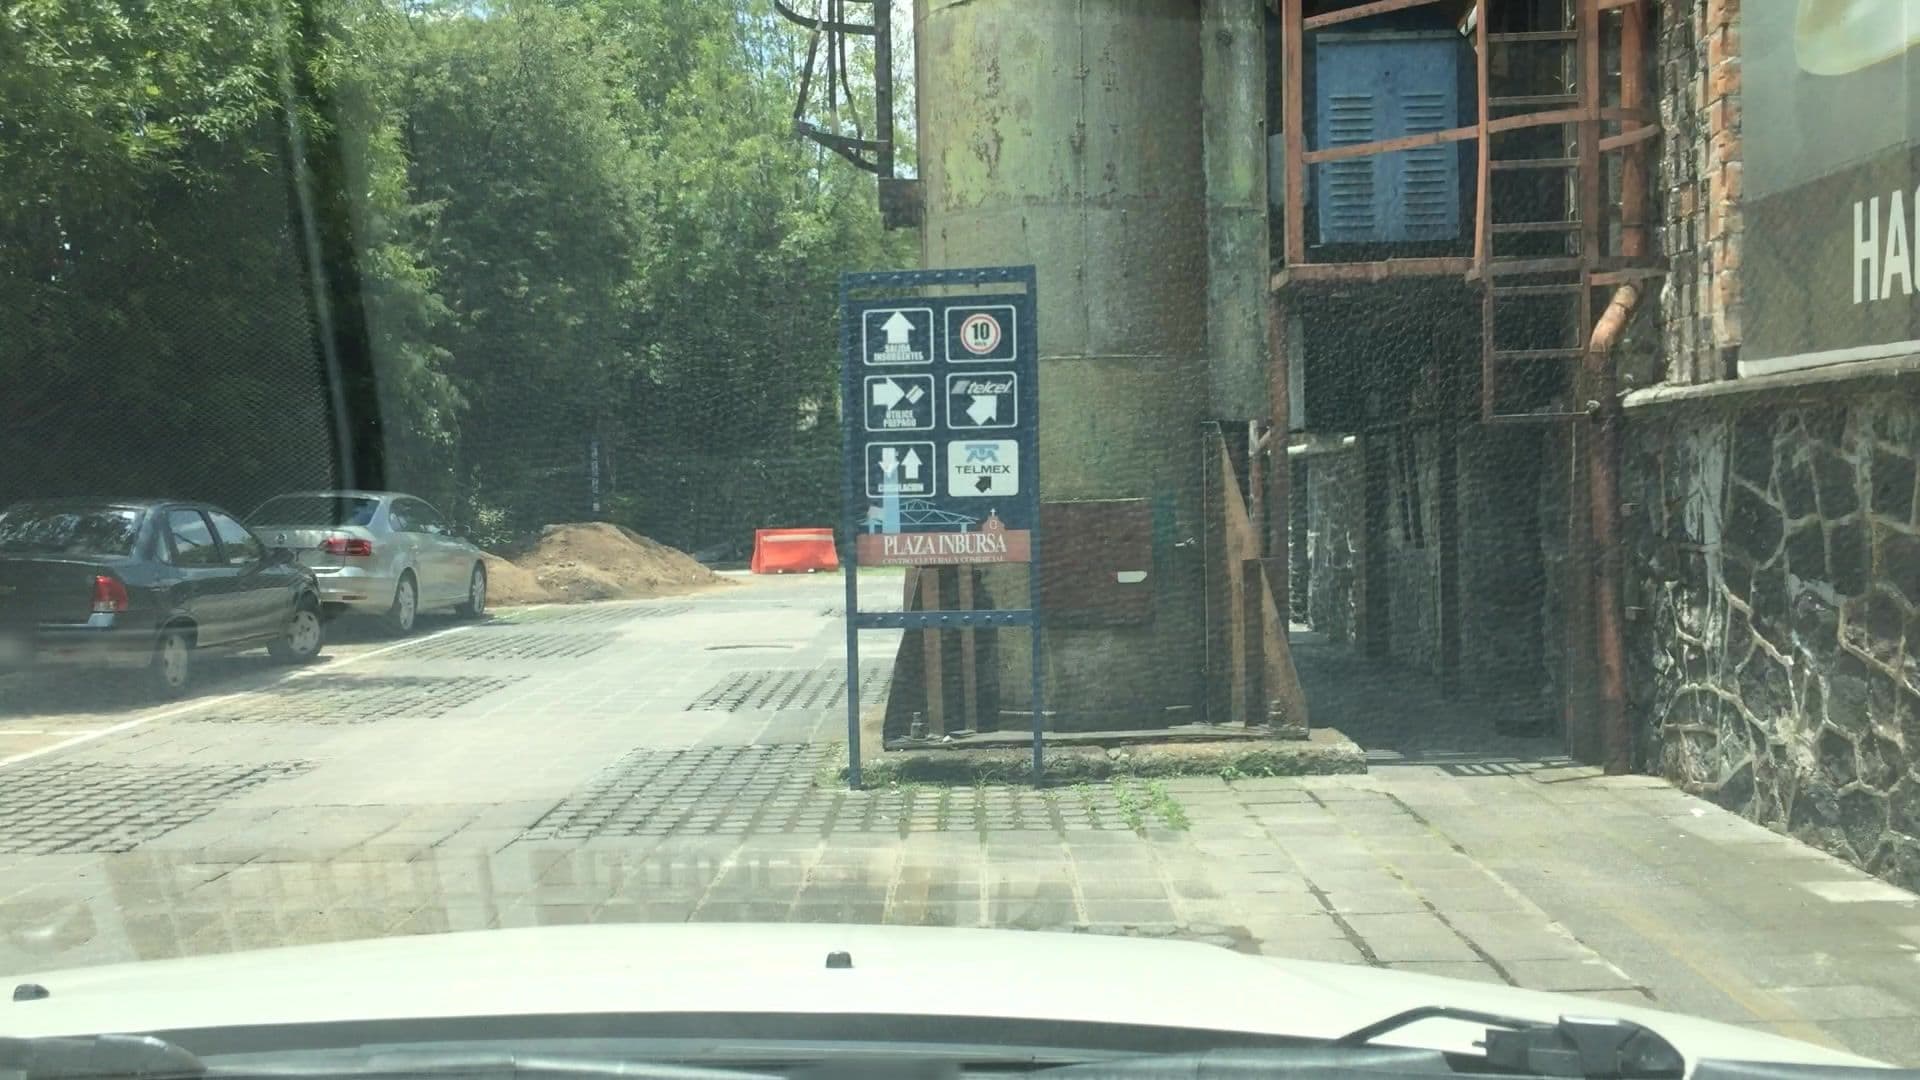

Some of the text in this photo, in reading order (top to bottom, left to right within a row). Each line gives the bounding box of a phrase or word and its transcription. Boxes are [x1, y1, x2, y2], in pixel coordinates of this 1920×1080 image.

[1854, 184, 1920, 305] HA
[971, 322, 990, 340] 10
[967, 380, 1013, 394] telcel
[955, 465, 1010, 474] TELMEX
[884, 533, 1007, 556] PLAZA INBURSA
